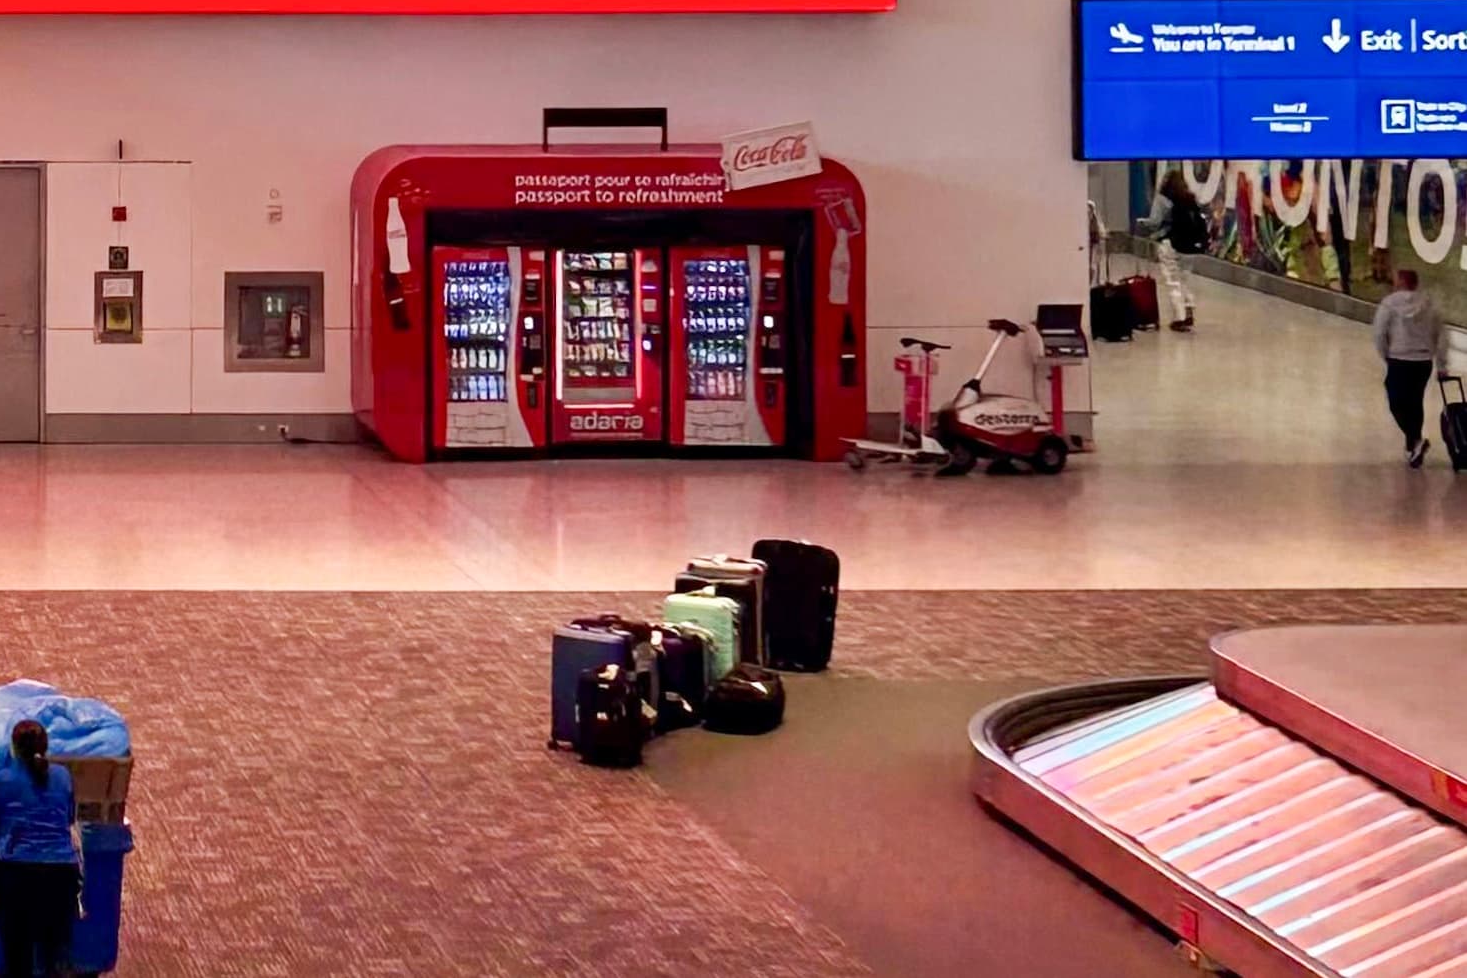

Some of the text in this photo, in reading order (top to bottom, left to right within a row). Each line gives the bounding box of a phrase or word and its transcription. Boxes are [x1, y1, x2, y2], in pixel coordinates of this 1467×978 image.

[1152, 37, 1181, 52] You
[1223, 36, 1286, 52] Terminal
[1361, 29, 1467, 51] Exit Sort
[734, 134, 808, 172] Coca-Cola
[595, 176, 630, 188] pour
[515, 188, 723, 205] passport to refreshment
